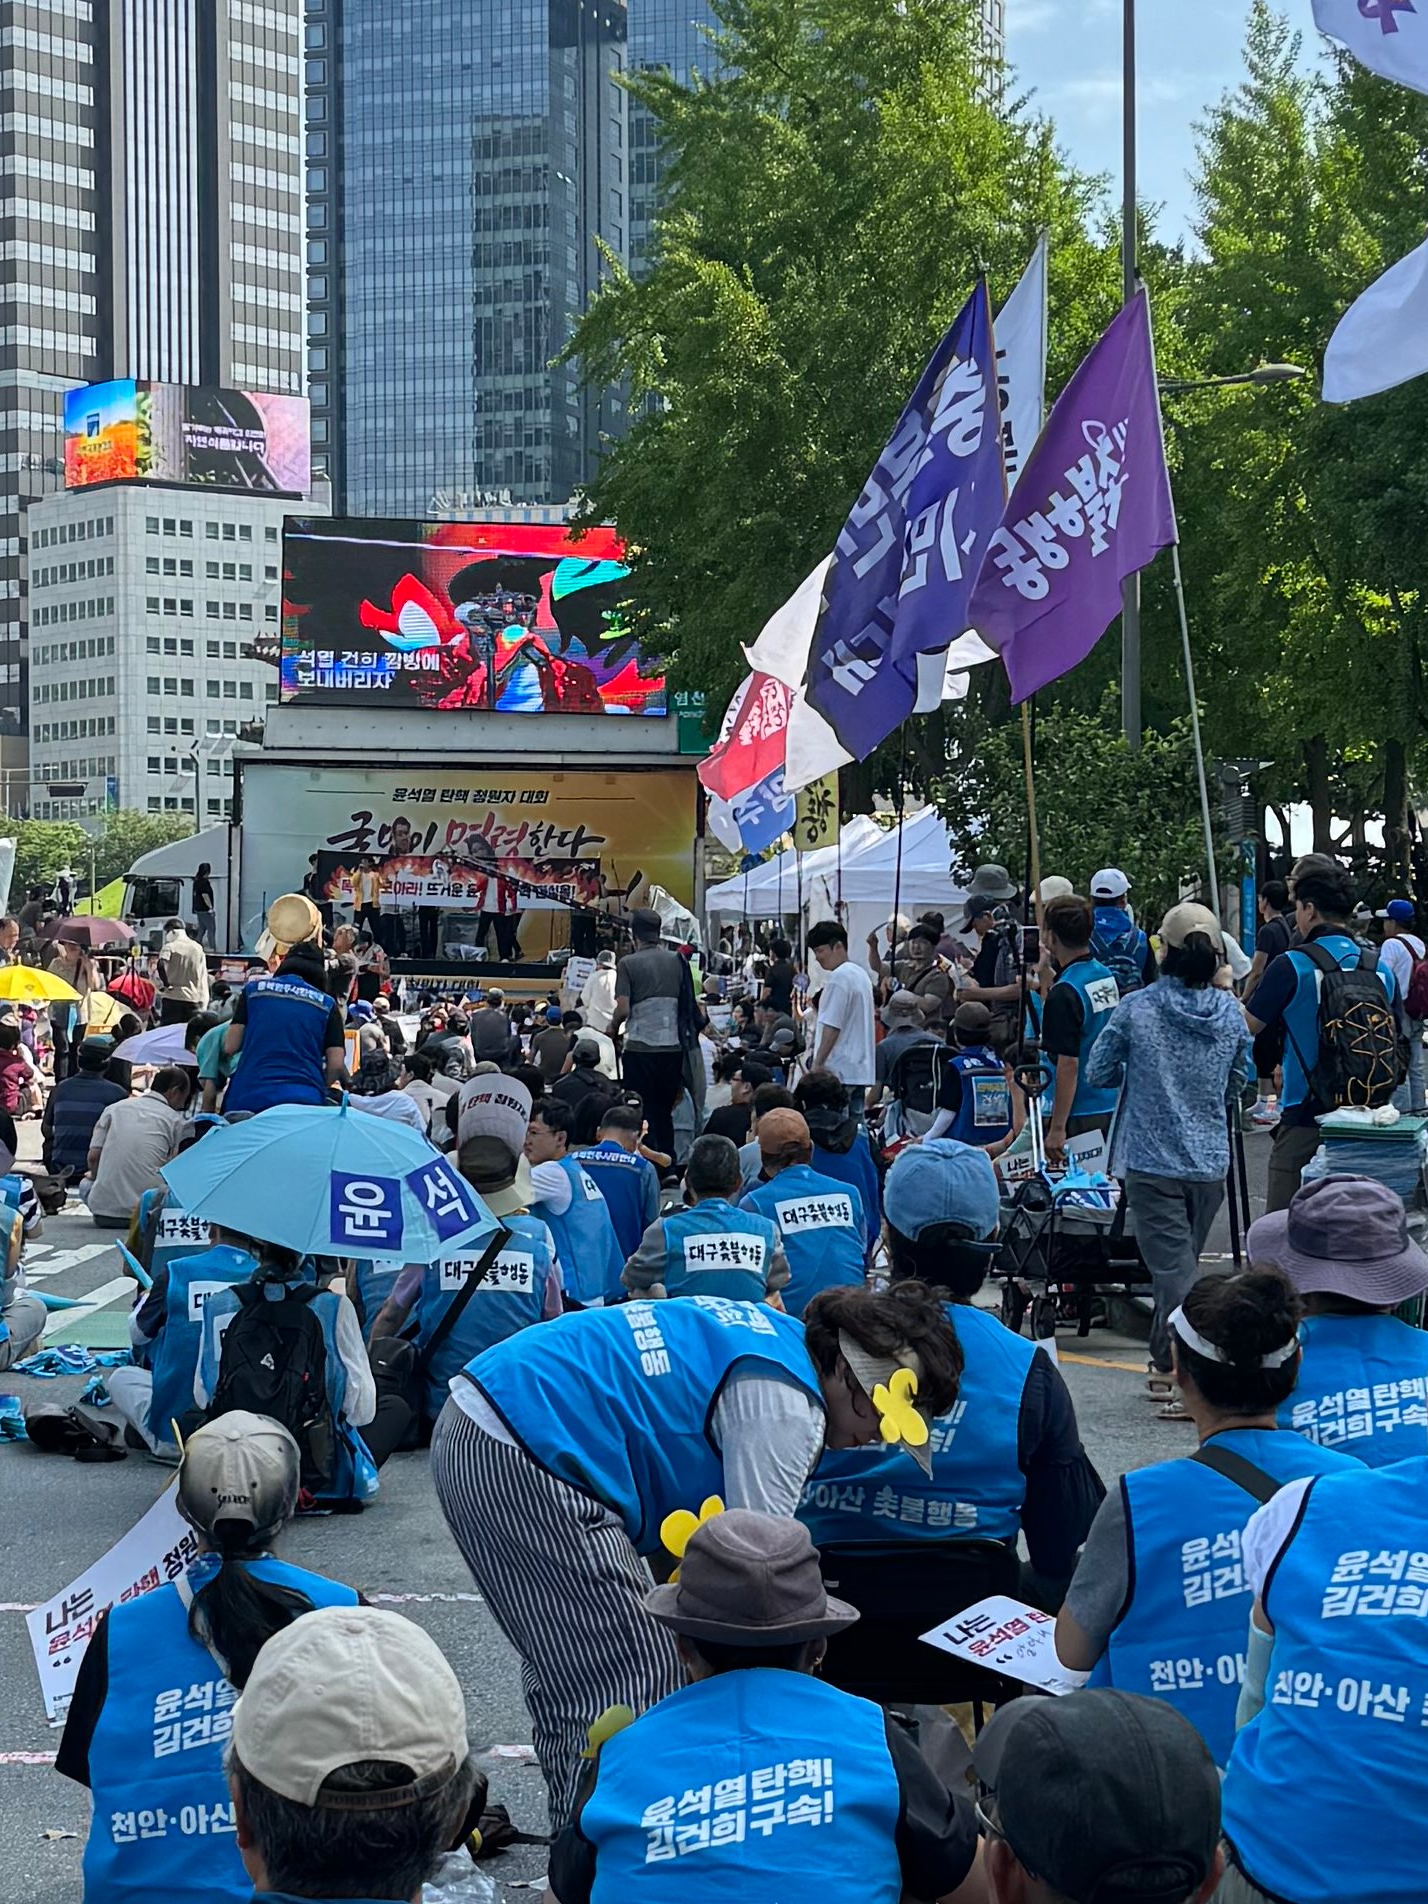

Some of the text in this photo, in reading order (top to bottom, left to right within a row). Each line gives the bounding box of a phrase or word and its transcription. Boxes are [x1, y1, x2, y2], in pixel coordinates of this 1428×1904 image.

[297, 671, 394, 690] 보내버리자
[392, 787, 549, 804] 윤석열 탄핵 청원자 대회
[338, 1165, 470, 1238] 윤 석
[782, 1202, 850, 1227] 대구촛불행동
[444, 1260, 529, 1286] 대구불행동
[688, 1240, 762, 1267] 대구촛불행동
[1291, 1387, 1371, 1427] 윤석열
[872, 1484, 978, 1528] 촛불행동
[1181, 1529, 1241, 1574] 윤석
[1182, 1570, 1251, 1608] 김건
[46, 1587, 94, 1635] 나는
[1272, 1668, 1410, 1723] 천안·아산
[641, 1757, 834, 1829] 윤석열 탄핵!
[645, 1790, 834, 1864] 김건희 구속!
